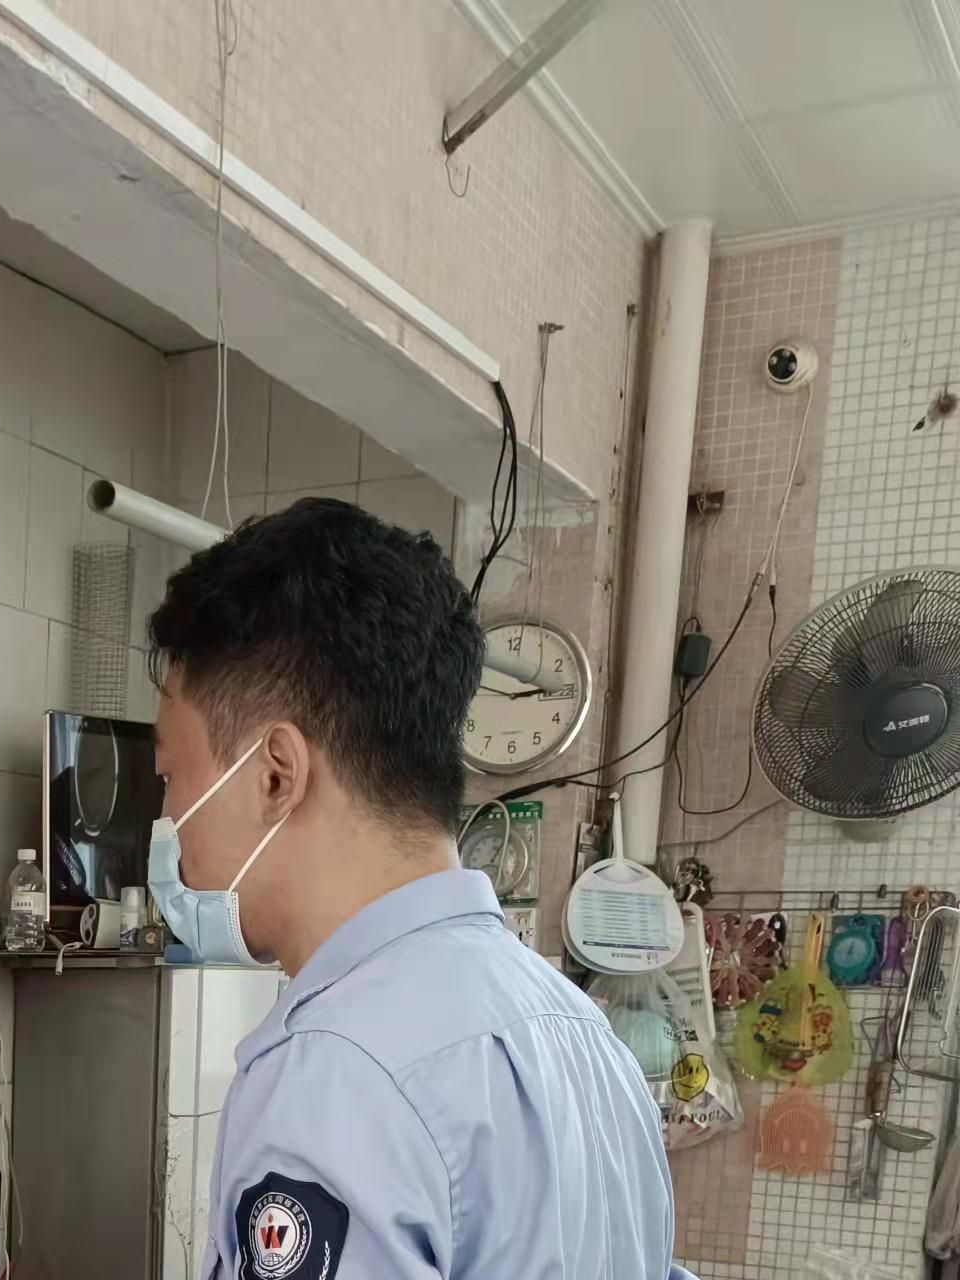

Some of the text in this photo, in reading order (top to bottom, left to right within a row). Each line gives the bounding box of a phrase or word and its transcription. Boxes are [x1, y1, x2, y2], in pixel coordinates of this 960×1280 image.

[508, 637, 521, 652] 12
[554, 658, 563, 672] 2
[552, 712, 560, 724] 4
[466, 720, 475, 732] 8
[484, 735, 491, 749] 7
[532, 732, 541, 745] 5
[507, 741, 516, 753] 6
